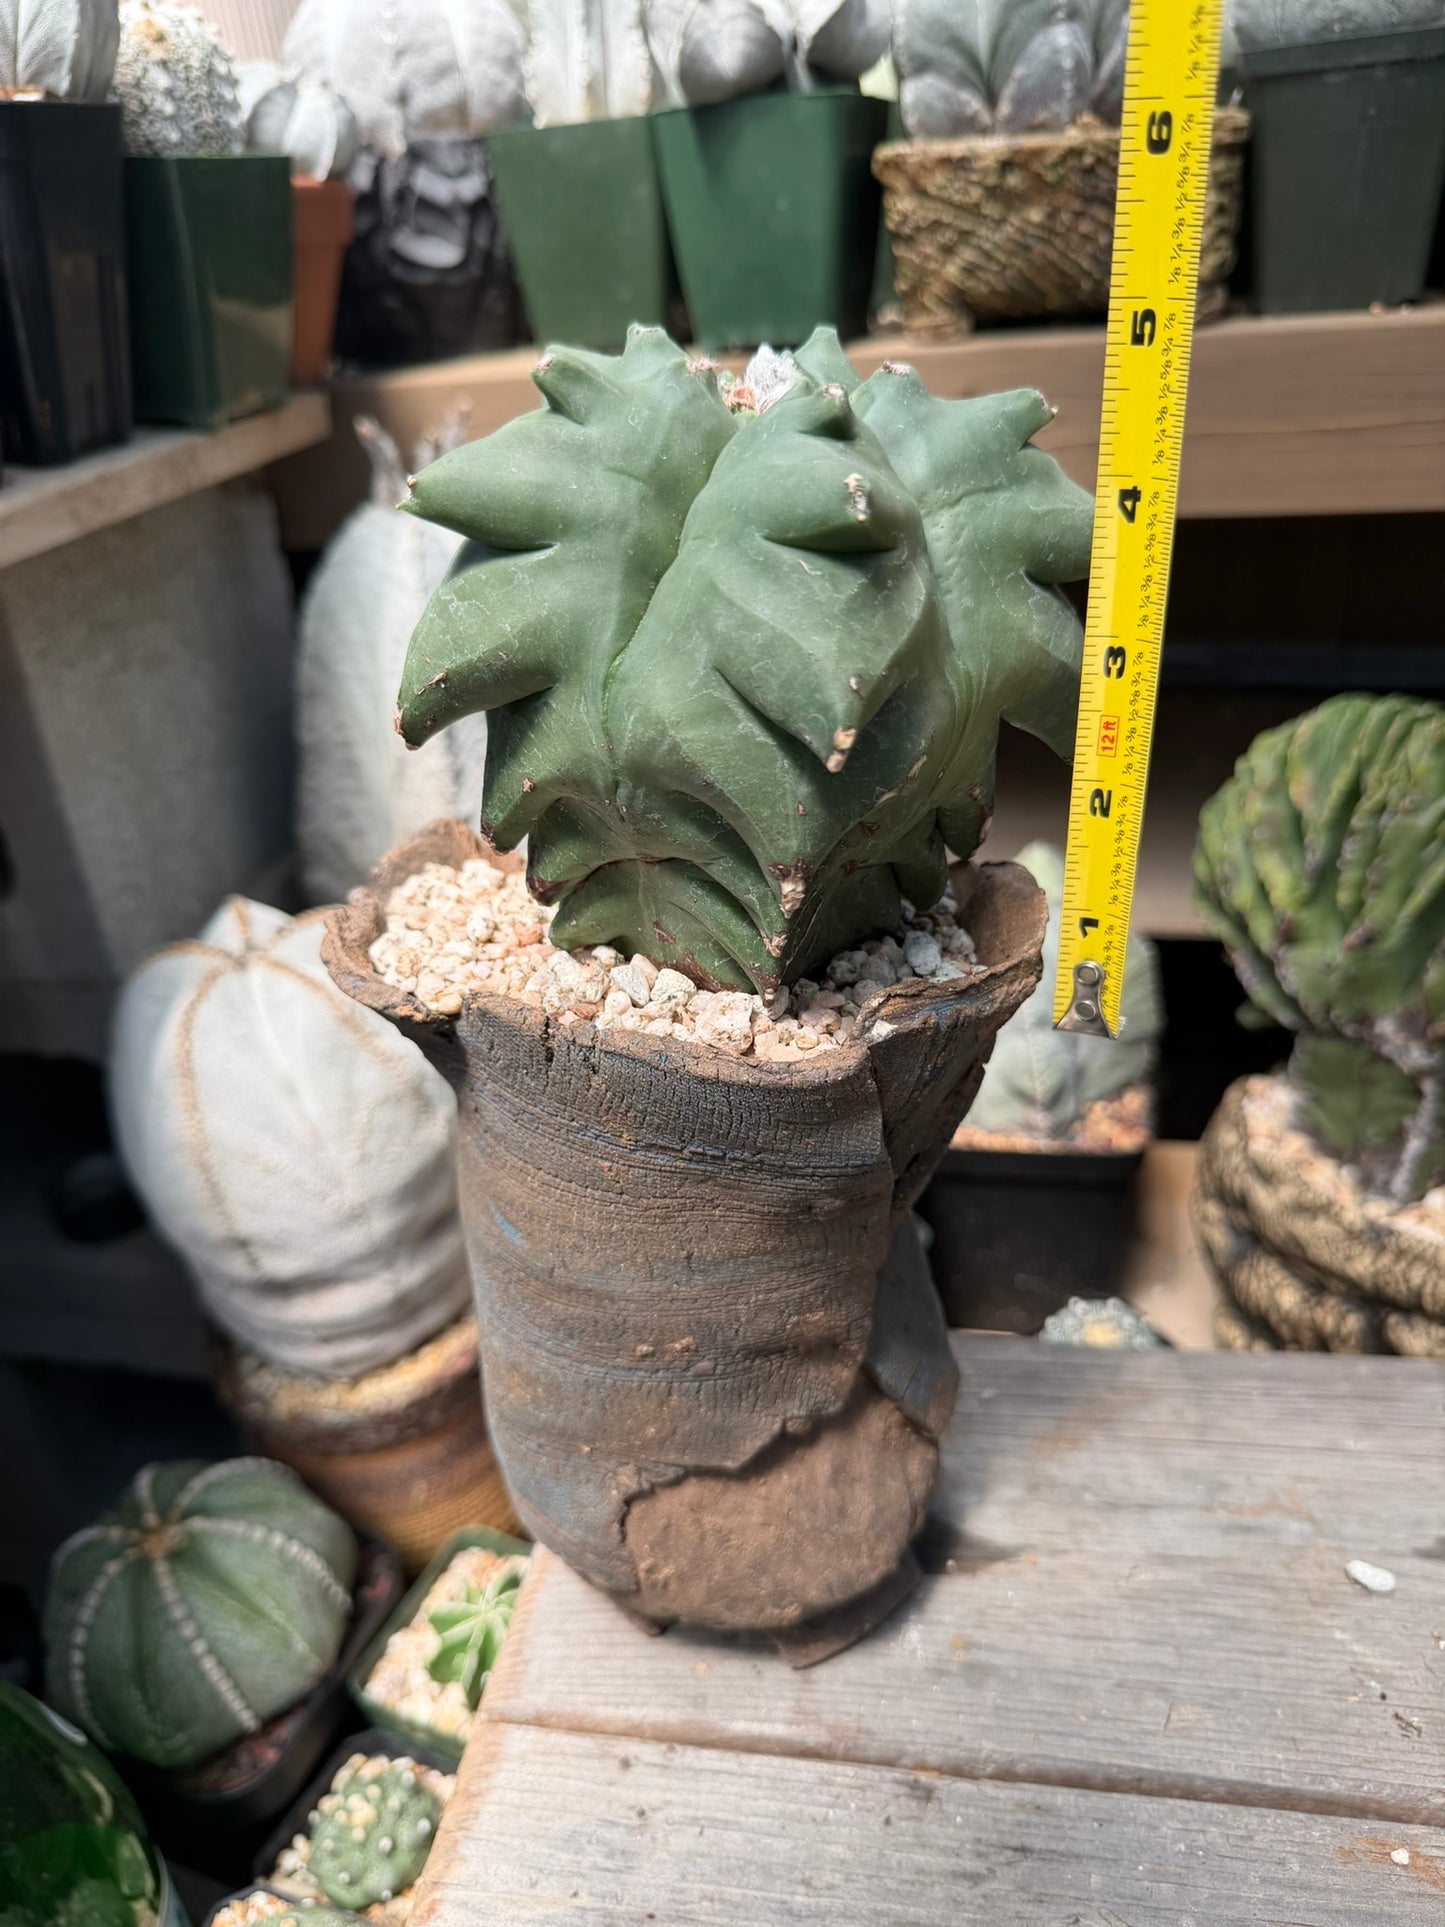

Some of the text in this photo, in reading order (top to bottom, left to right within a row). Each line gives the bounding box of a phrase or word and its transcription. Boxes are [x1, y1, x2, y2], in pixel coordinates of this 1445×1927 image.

[1146, 110, 1173, 155] 6
[1174, 193, 1189, 212] 1/2
[1171, 217, 1186, 239] 3/8
[1169, 243, 1184, 262] 1/4
[1167, 267, 1182, 285] 1/8
[1130, 308, 1157, 348] 5
[1163, 312, 1177, 332] 7/8
[1161, 337, 1174, 357] 3/4
[1160, 359, 1173, 380] 5/8
[1158, 383, 1171, 401] 1/2
[1155, 406, 1169, 426] 3/8
[1153, 428, 1167, 446] 1/4
[1152, 450, 1165, 466] 1/8
[1118, 485, 1142, 524] 4
[1147, 491, 1160, 508] 7/8
[1146, 513, 1158, 531] 3/4
[1144, 533, 1157, 552] 5/8
[1143, 554, 1156, 570] 1/2
[1140, 574, 1153, 592] 3/8
[1139, 595, 1151, 611] 1/4
[1137, 614, 1150, 630] 1/8
[1103, 645, 1127, 680] 3
[1132, 651, 1144, 668] 7/8
[1130, 671, 1142, 688] 3/4
[1129, 690, 1141, 707] 5/8
[1128, 709, 1140, 724] 1/2
[1101, 720, 1117, 753] 12 ft
[1125, 727, 1138, 743] 3/8
[1124, 745, 1135, 760] 1/4
[1122, 762, 1134, 776] 1/8
[1089, 788, 1112, 819] 2
[1117, 795, 1129, 810] 7/8
[1115, 813, 1127, 828] 3/4
[1114, 829, 1126, 845] 5/8
[1113, 846, 1124, 860] 1/2
[1110, 863, 1122, 877] 3/8
[1109, 879, 1121, 892] 1/4
[1108, 894, 1119, 907] 1/8
[1079, 917, 1100, 939] 1
